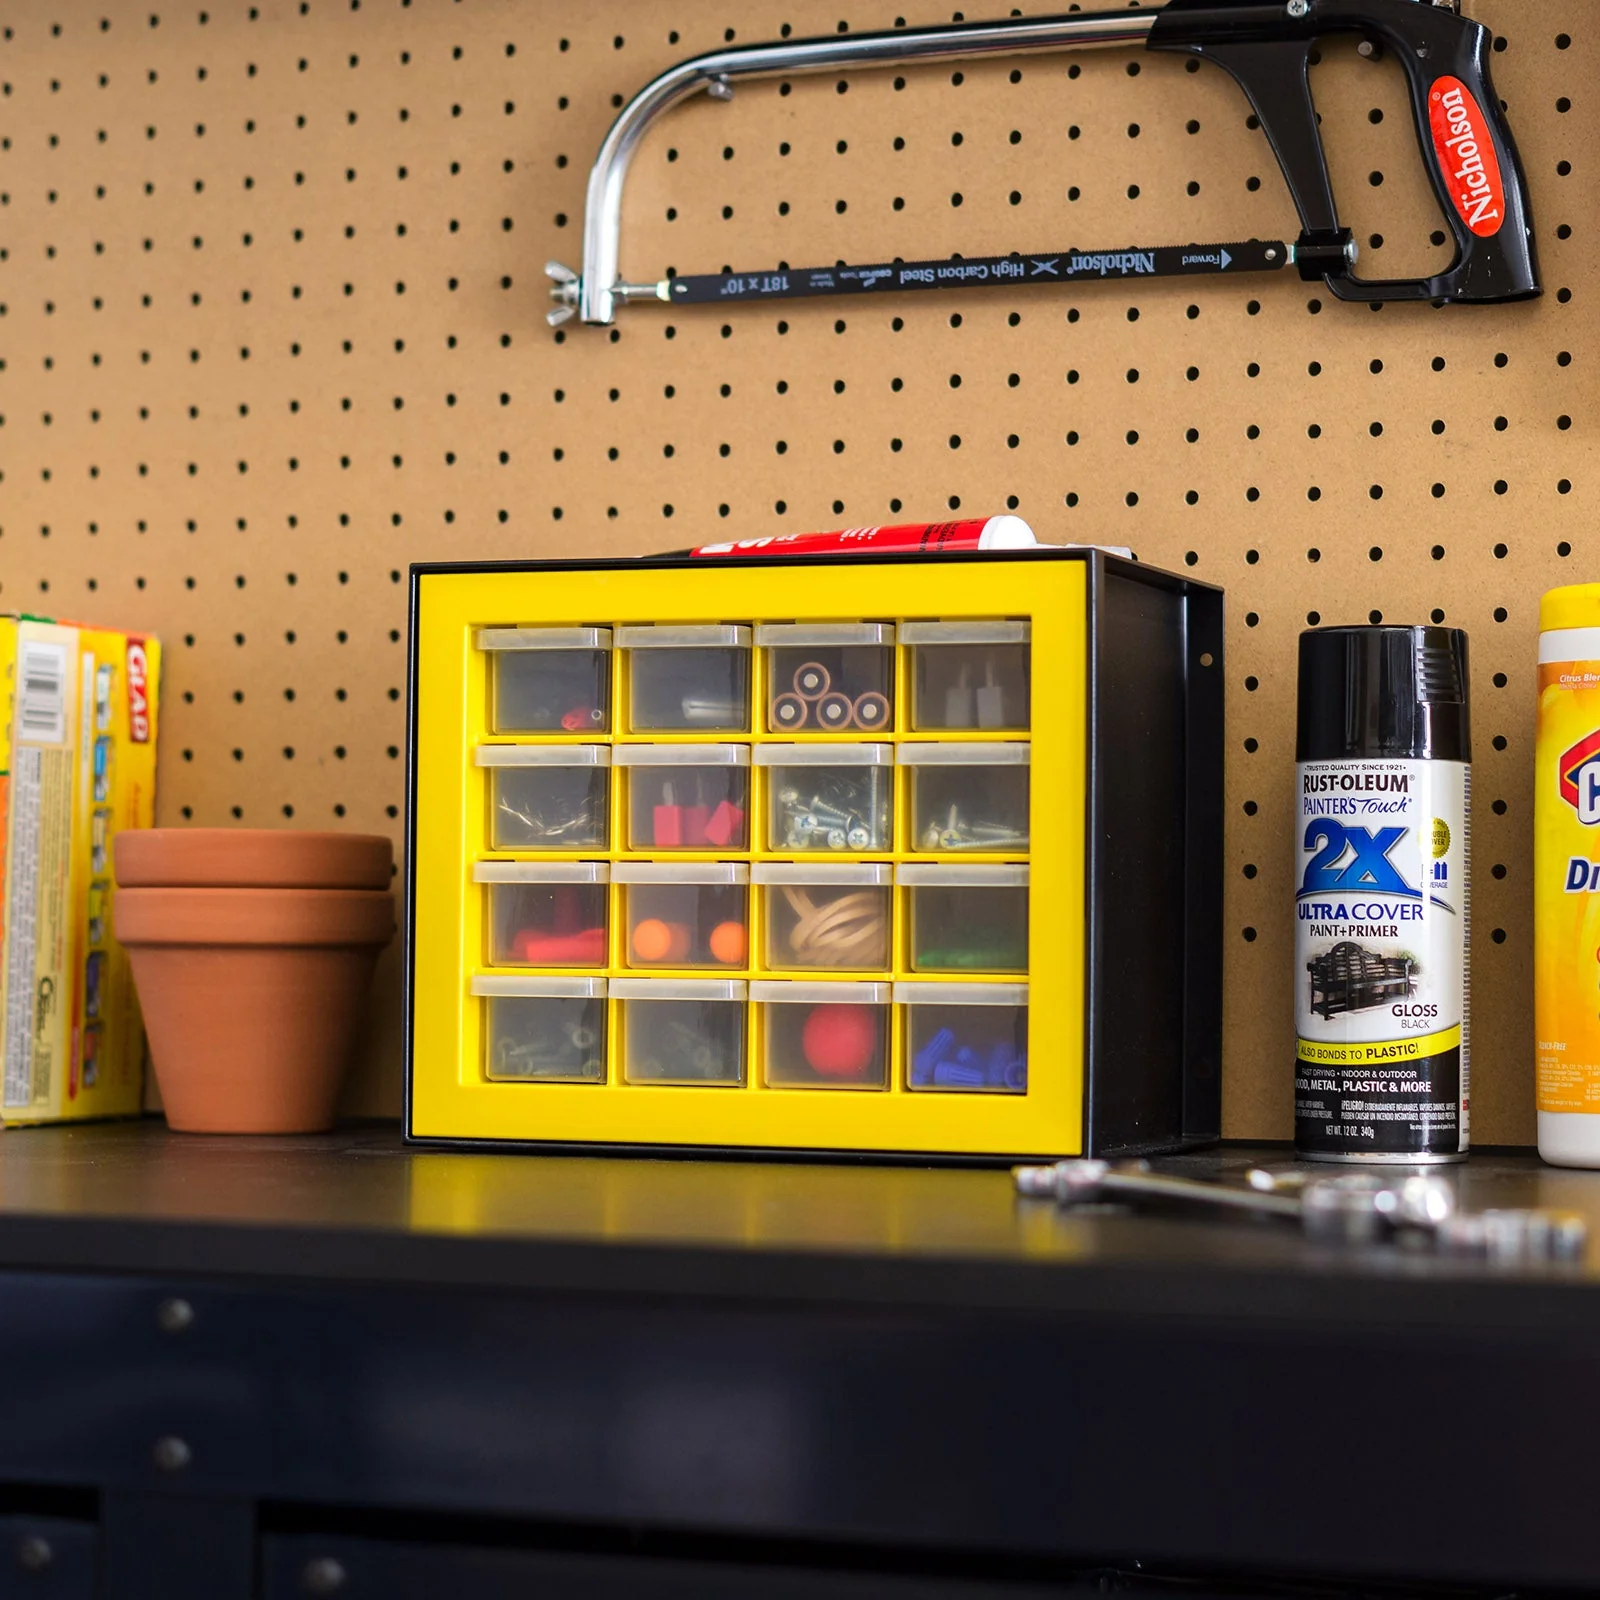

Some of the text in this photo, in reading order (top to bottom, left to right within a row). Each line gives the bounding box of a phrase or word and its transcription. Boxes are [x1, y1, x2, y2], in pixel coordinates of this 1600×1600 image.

[1182, 254, 1220, 266] Forward
[900, 268, 935, 284] Steel
[937, 264, 988, 279] Carbon
[992, 262, 1025, 277] High
[720, 275, 790, 295] 18T x 10"
[1560, 674, 1582, 683] Citrus
[127, 644, 149, 741] GLAD
[1330, 764, 1360, 772] QUALITY
[1304, 797, 1357, 815] PAINTER'S
[1303, 818, 1411, 889] 2X
[1299, 904, 1424, 920] ULTRA COVER
[1392, 1004, 1438, 1018] GLOSS
[1401, 1019, 1430, 1029] BLACK
[1301, 1043, 1419, 1060] ALSO BONDS TO PLASTIC!
[1313, 1069, 1336, 1077] DRYING
[1341, 1070, 1371, 1078] INDOOR
[1371, 1070, 1378, 1078] &
[1378, 1070, 1417, 1079] OUTDOOR
[1295, 1078, 1432, 1093] OOD, METAL, PLASTIC & MORE
[1343, 1126, 1350, 1136] 12
[1350, 1126, 1359, 1136] OZ.
[1361, 1126, 1375, 1139] 340g
